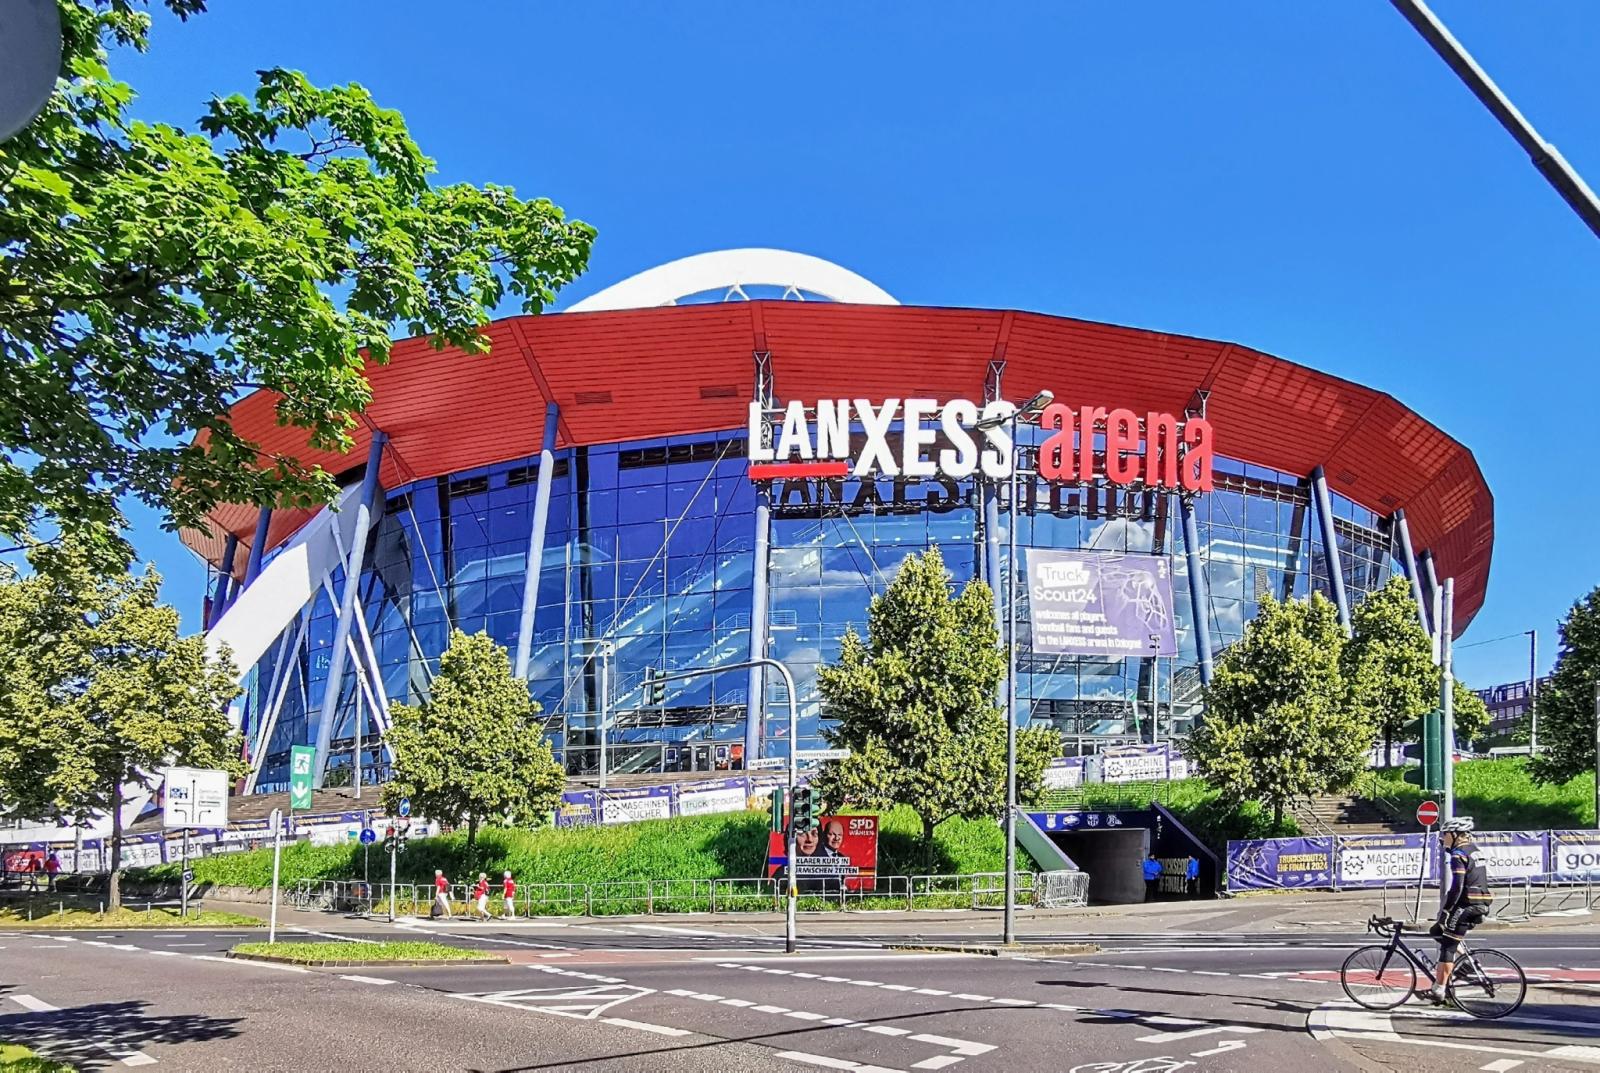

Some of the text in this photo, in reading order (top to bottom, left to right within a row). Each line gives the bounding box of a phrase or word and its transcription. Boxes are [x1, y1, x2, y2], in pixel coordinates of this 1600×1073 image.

[749, 398, 1214, 493] LANXESS arena
[1043, 567, 1084, 581] Truck
[1034, 588, 1097, 603] Scout24
[1066, 624, 1081, 633] fans
[1082, 624, 1095, 634] and
[1038, 635, 1046, 645] to
[1047, 636, 1059, 645] the
[1125, 757, 1163, 768] MACHINE
[620, 799, 668, 810] MASCHINEN
[629, 808, 662, 819] SUCHER
[849, 818, 874, 830] SPD
[796, 857, 821, 865] KLARER
[822, 857, 840, 865] KURS
[1279, 853, 1328, 864] TRUCKSCOUT24
[1489, 856, 1540, 867] Scout24
[1277, 863, 1290, 872] EHF
[1311, 861, 1328, 870] 2024
[1376, 864, 1419, 876] SUCHER
